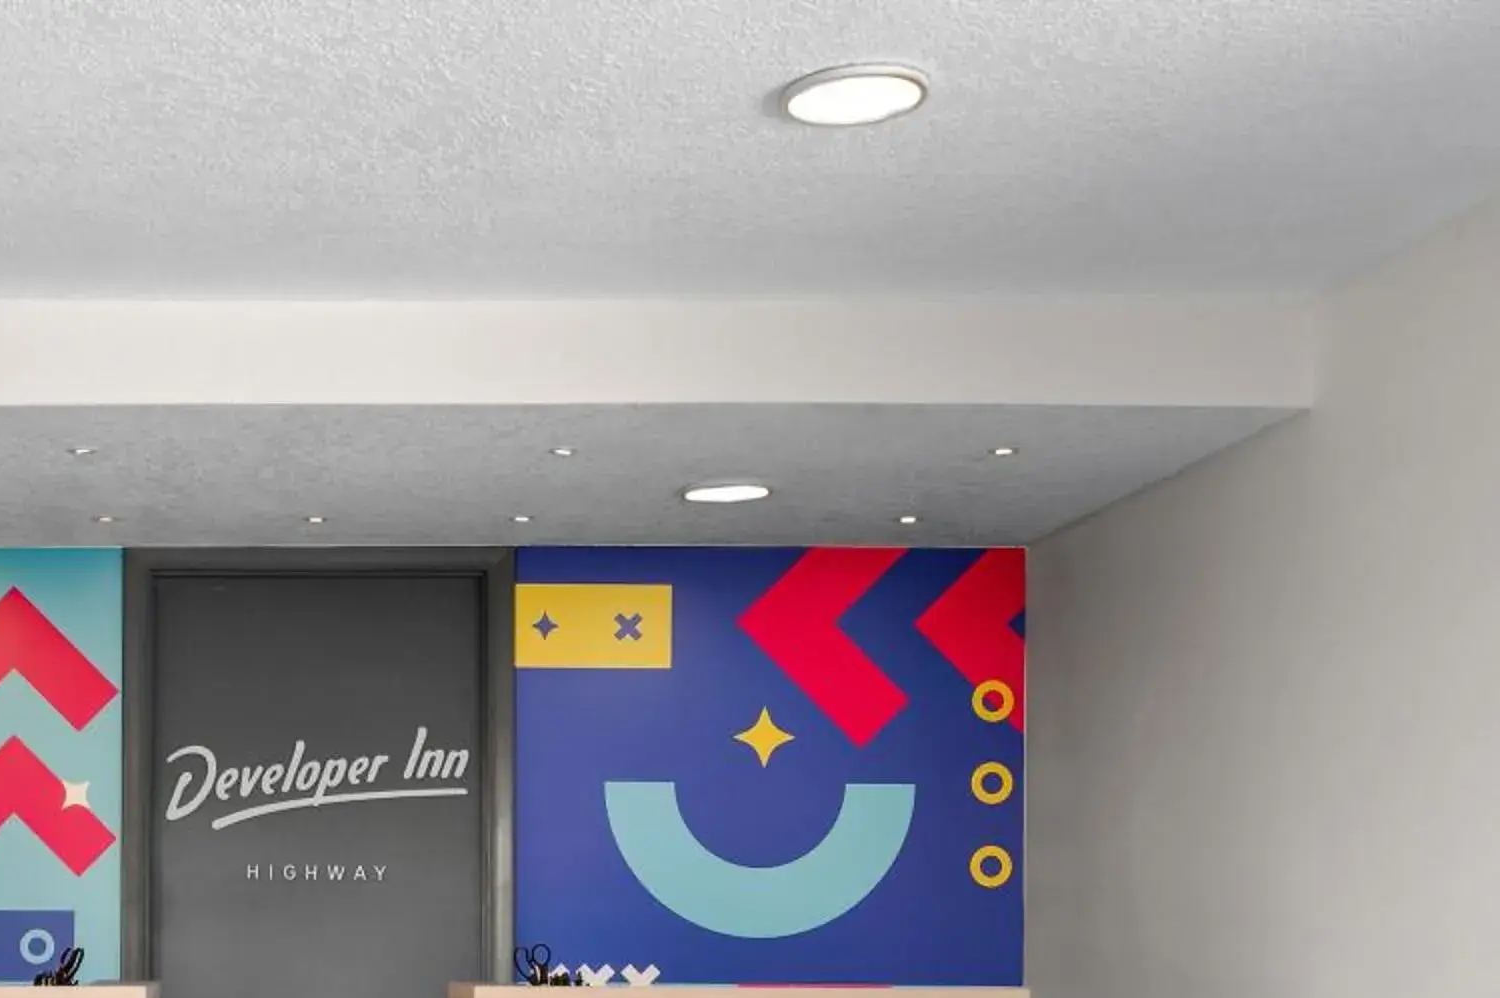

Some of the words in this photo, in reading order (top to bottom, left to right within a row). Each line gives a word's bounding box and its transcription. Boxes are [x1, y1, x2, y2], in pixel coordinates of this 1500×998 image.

[165, 738, 390, 821] Developer
[403, 726, 470, 780] Inn
[246, 863, 388, 881] HIGHWAY
